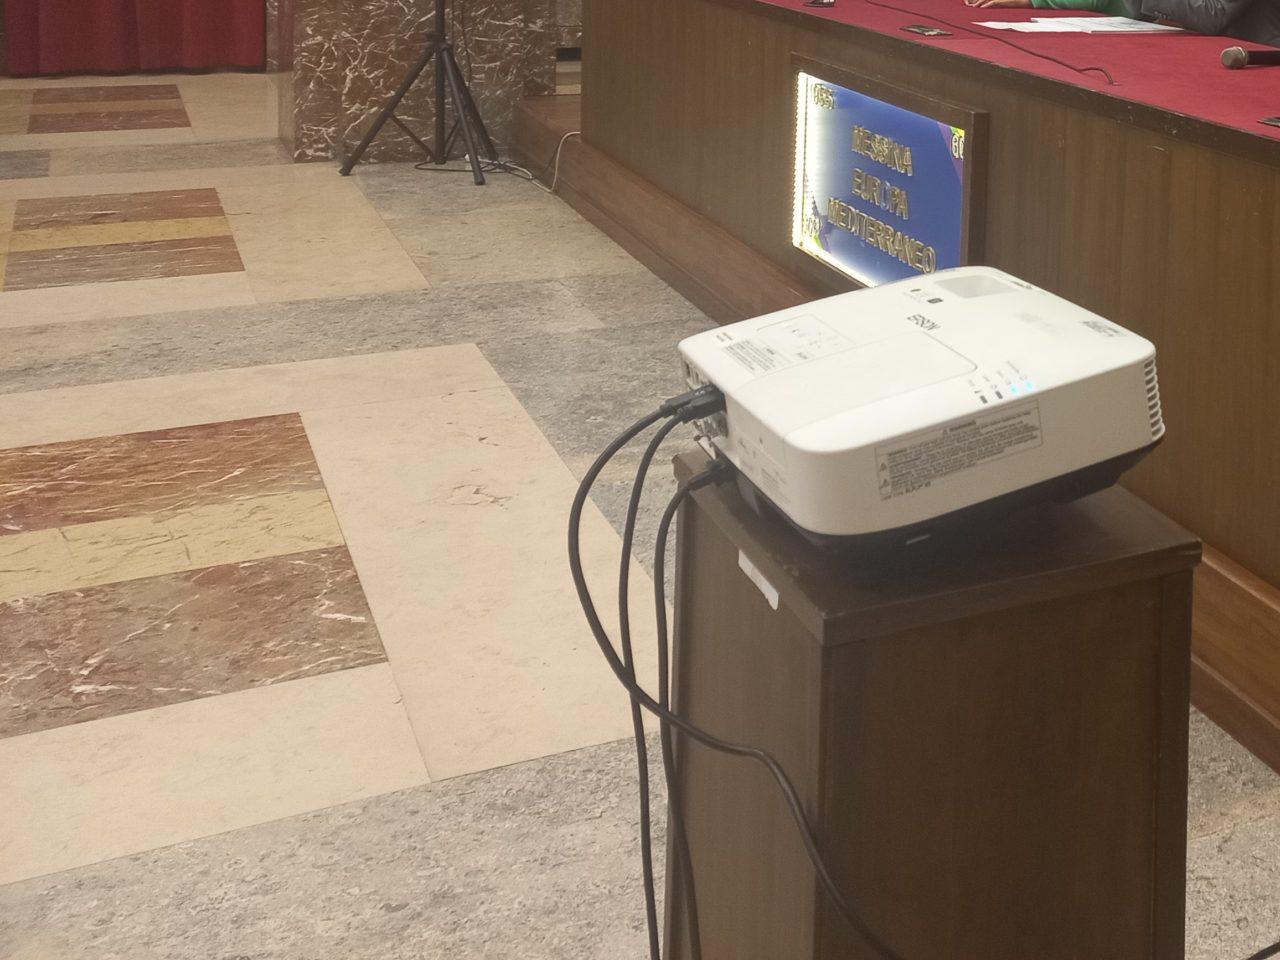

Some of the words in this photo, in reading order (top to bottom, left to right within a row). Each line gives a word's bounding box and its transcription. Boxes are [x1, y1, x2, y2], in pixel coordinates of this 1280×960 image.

[851, 125, 913, 176] MESSINA
[851, 168, 909, 220] EUROPA
[828, 197, 937, 274] MEDITERRANEO
